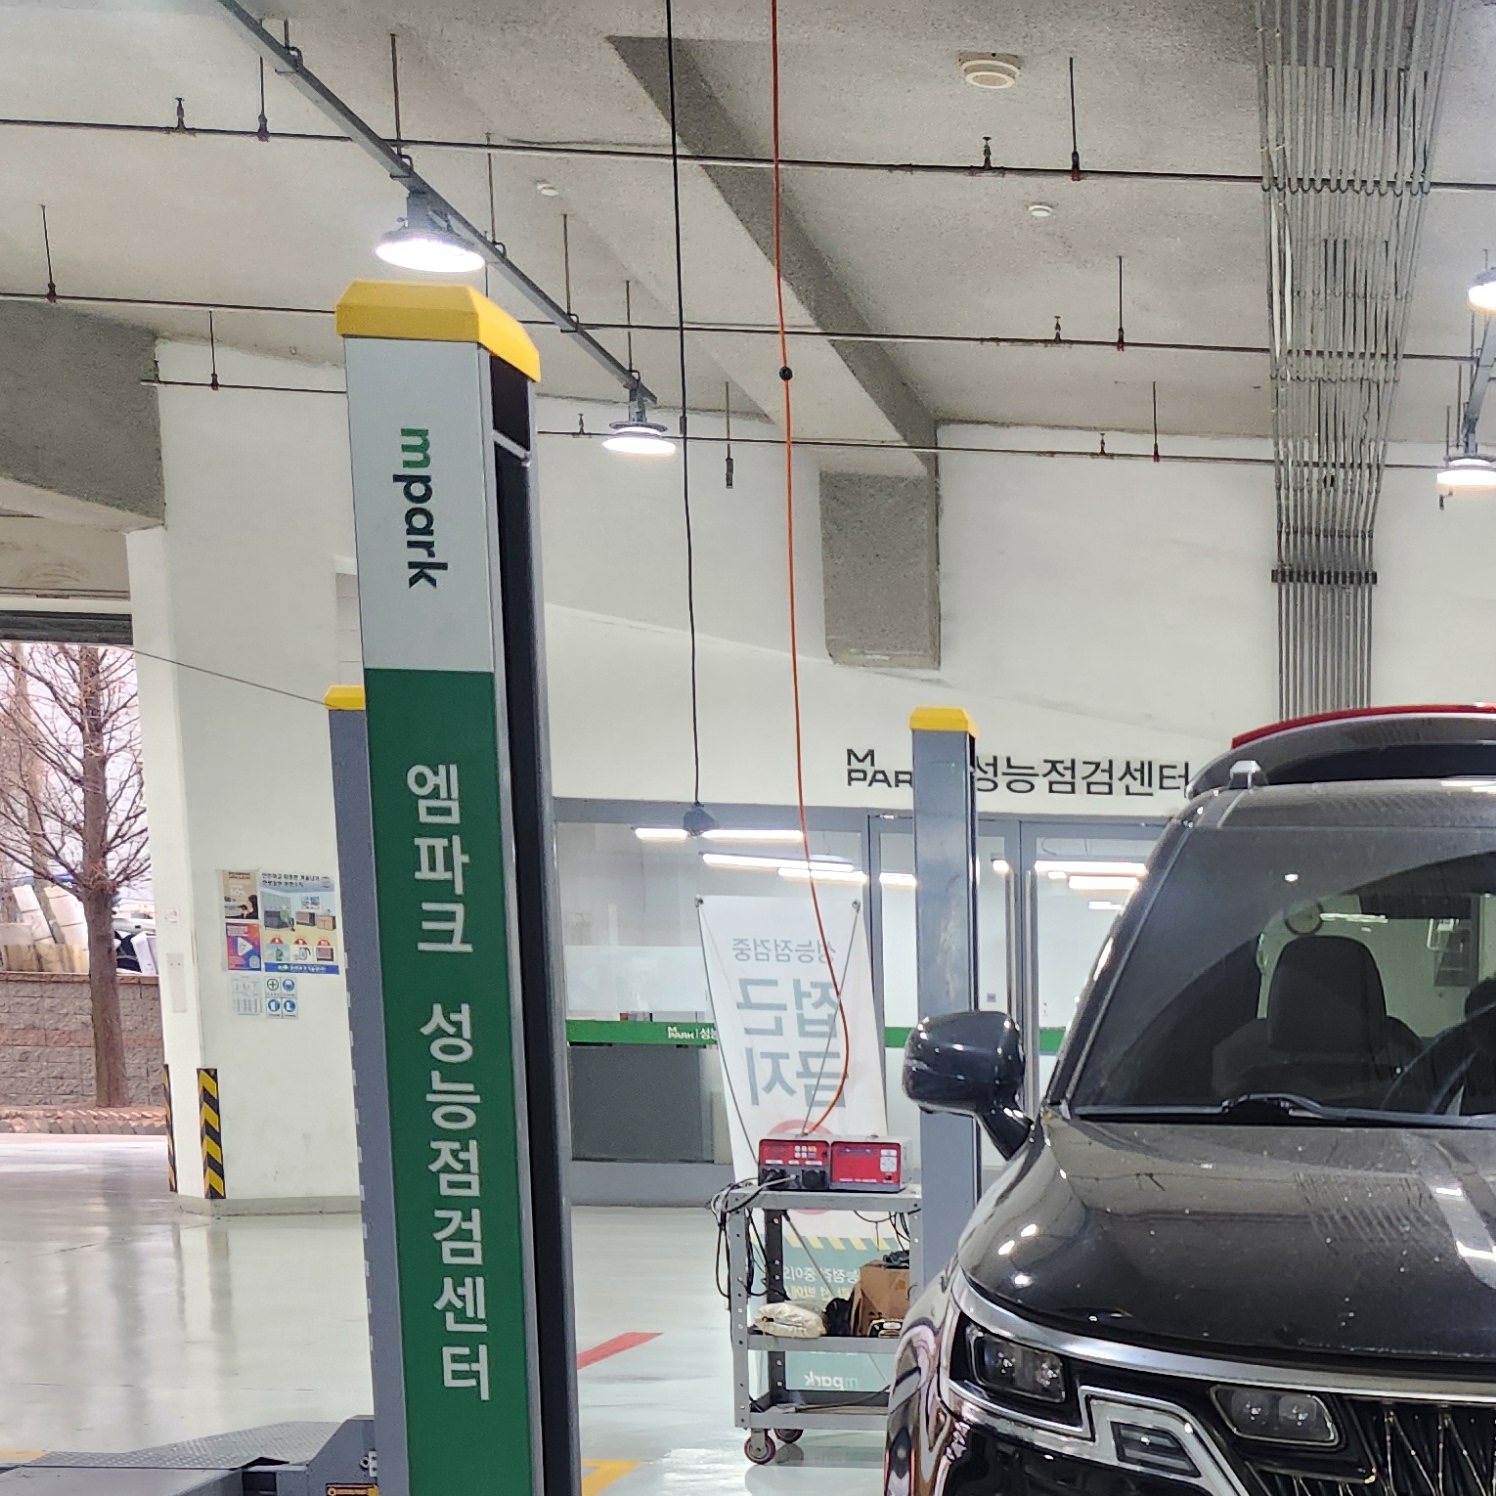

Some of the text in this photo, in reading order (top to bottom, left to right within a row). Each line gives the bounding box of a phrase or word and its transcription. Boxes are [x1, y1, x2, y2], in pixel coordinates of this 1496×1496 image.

[393, 428, 449, 589] mpark
[847, 748, 875, 767] M
[847, 768, 914, 788] PAR
[974, 755, 1190, 797] 성능점검센터
[406, 764, 490, 1401] 엠파크 성능점검센터
